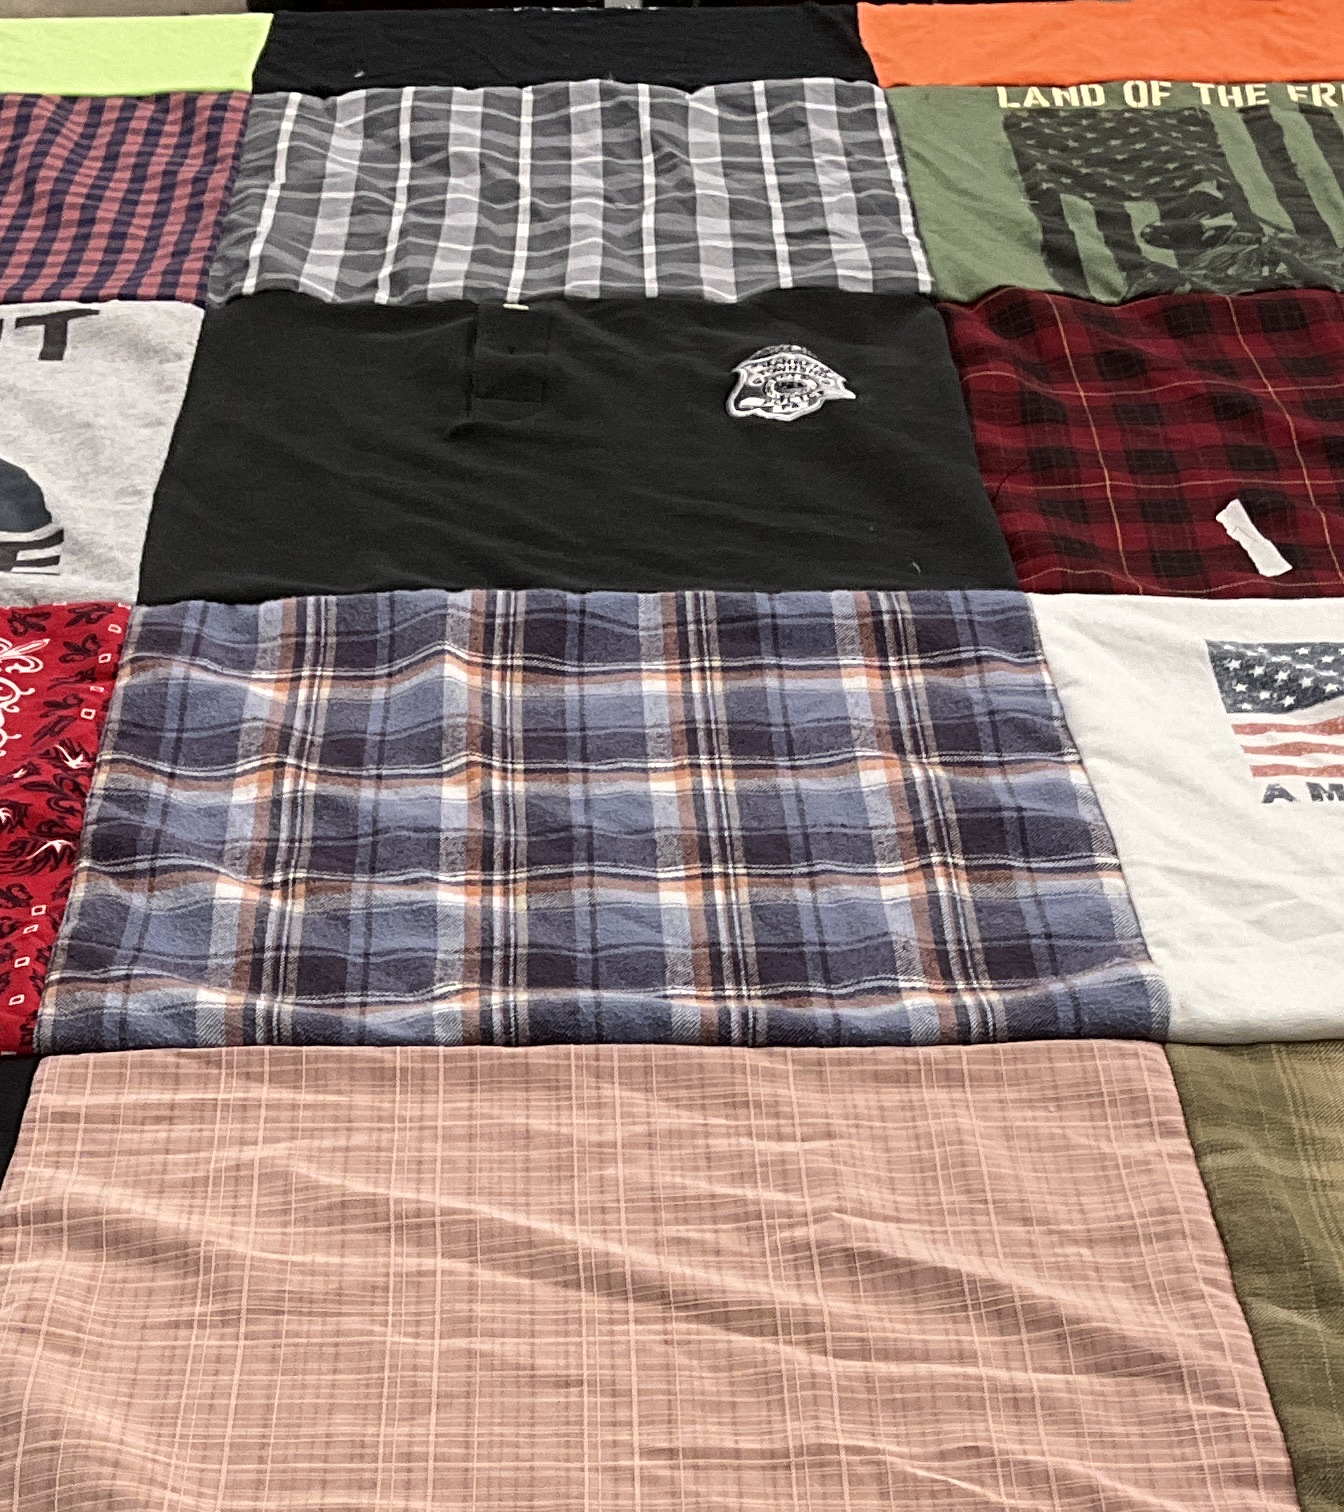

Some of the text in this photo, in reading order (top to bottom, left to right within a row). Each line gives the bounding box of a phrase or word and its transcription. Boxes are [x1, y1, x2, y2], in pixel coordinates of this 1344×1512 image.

[996, 83, 1106, 108] LAND
[1123, 79, 1172, 107] OF
[1191, 81, 1271, 108] THE
